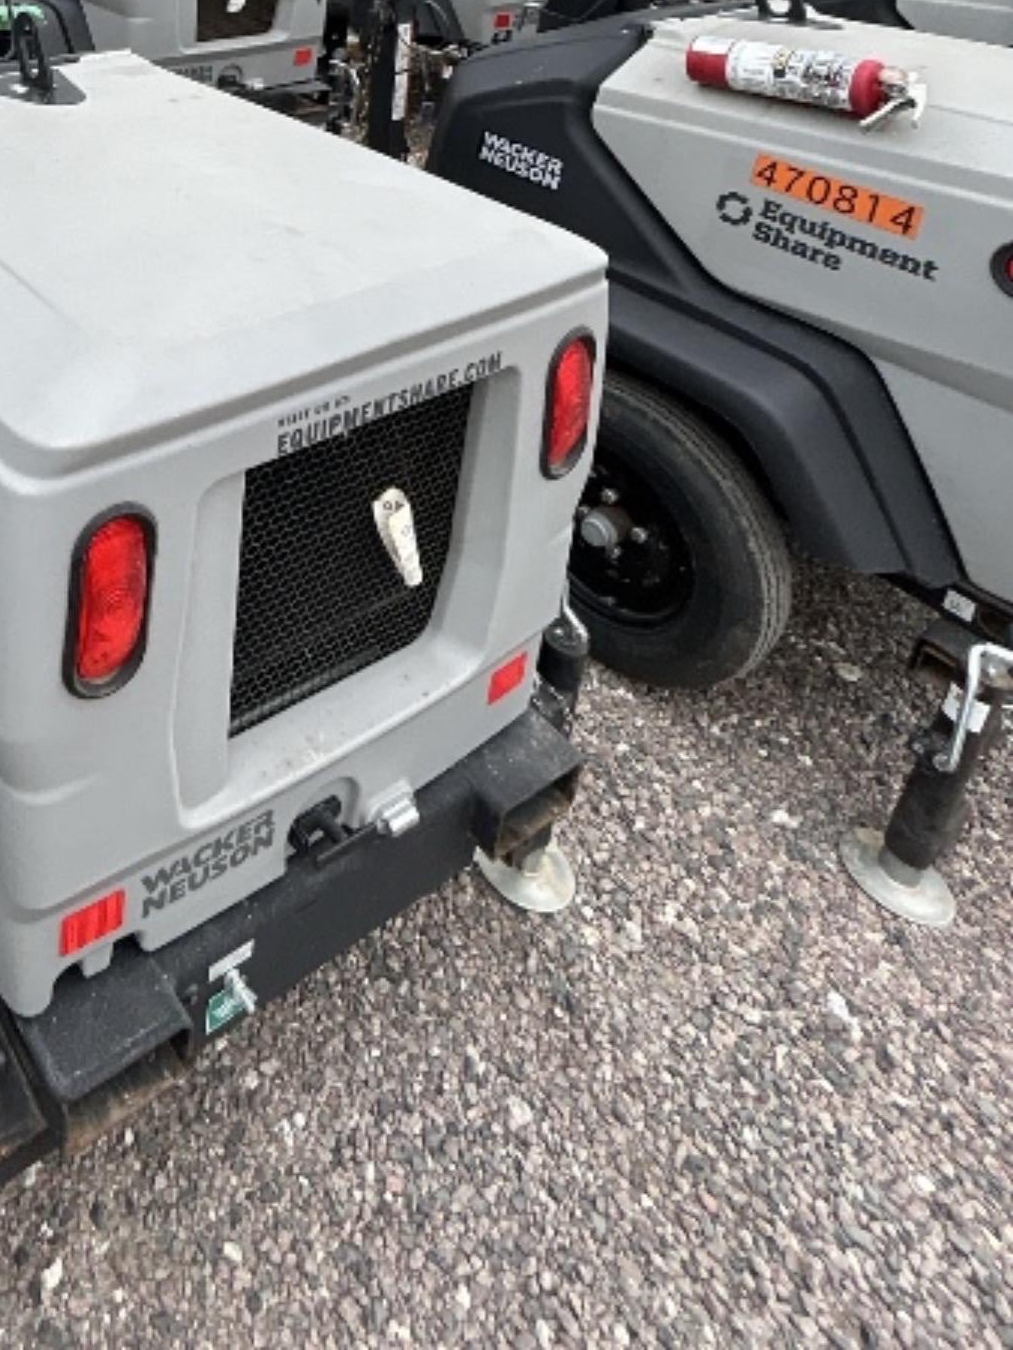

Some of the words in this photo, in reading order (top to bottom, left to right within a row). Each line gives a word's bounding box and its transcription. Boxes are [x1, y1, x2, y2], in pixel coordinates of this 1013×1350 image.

[479, 146, 561, 189] NEUSON
[484, 131, 564, 175] WACKER
[756, 161, 916, 235] 470814
[752, 221, 842, 271] Share
[760, 198, 939, 282] Equipment
[277, 351, 503, 457] EQUIPMENTSHARE.COM
[141, 810, 275, 894] WACKER
[142, 828, 275, 918] NEUSON
